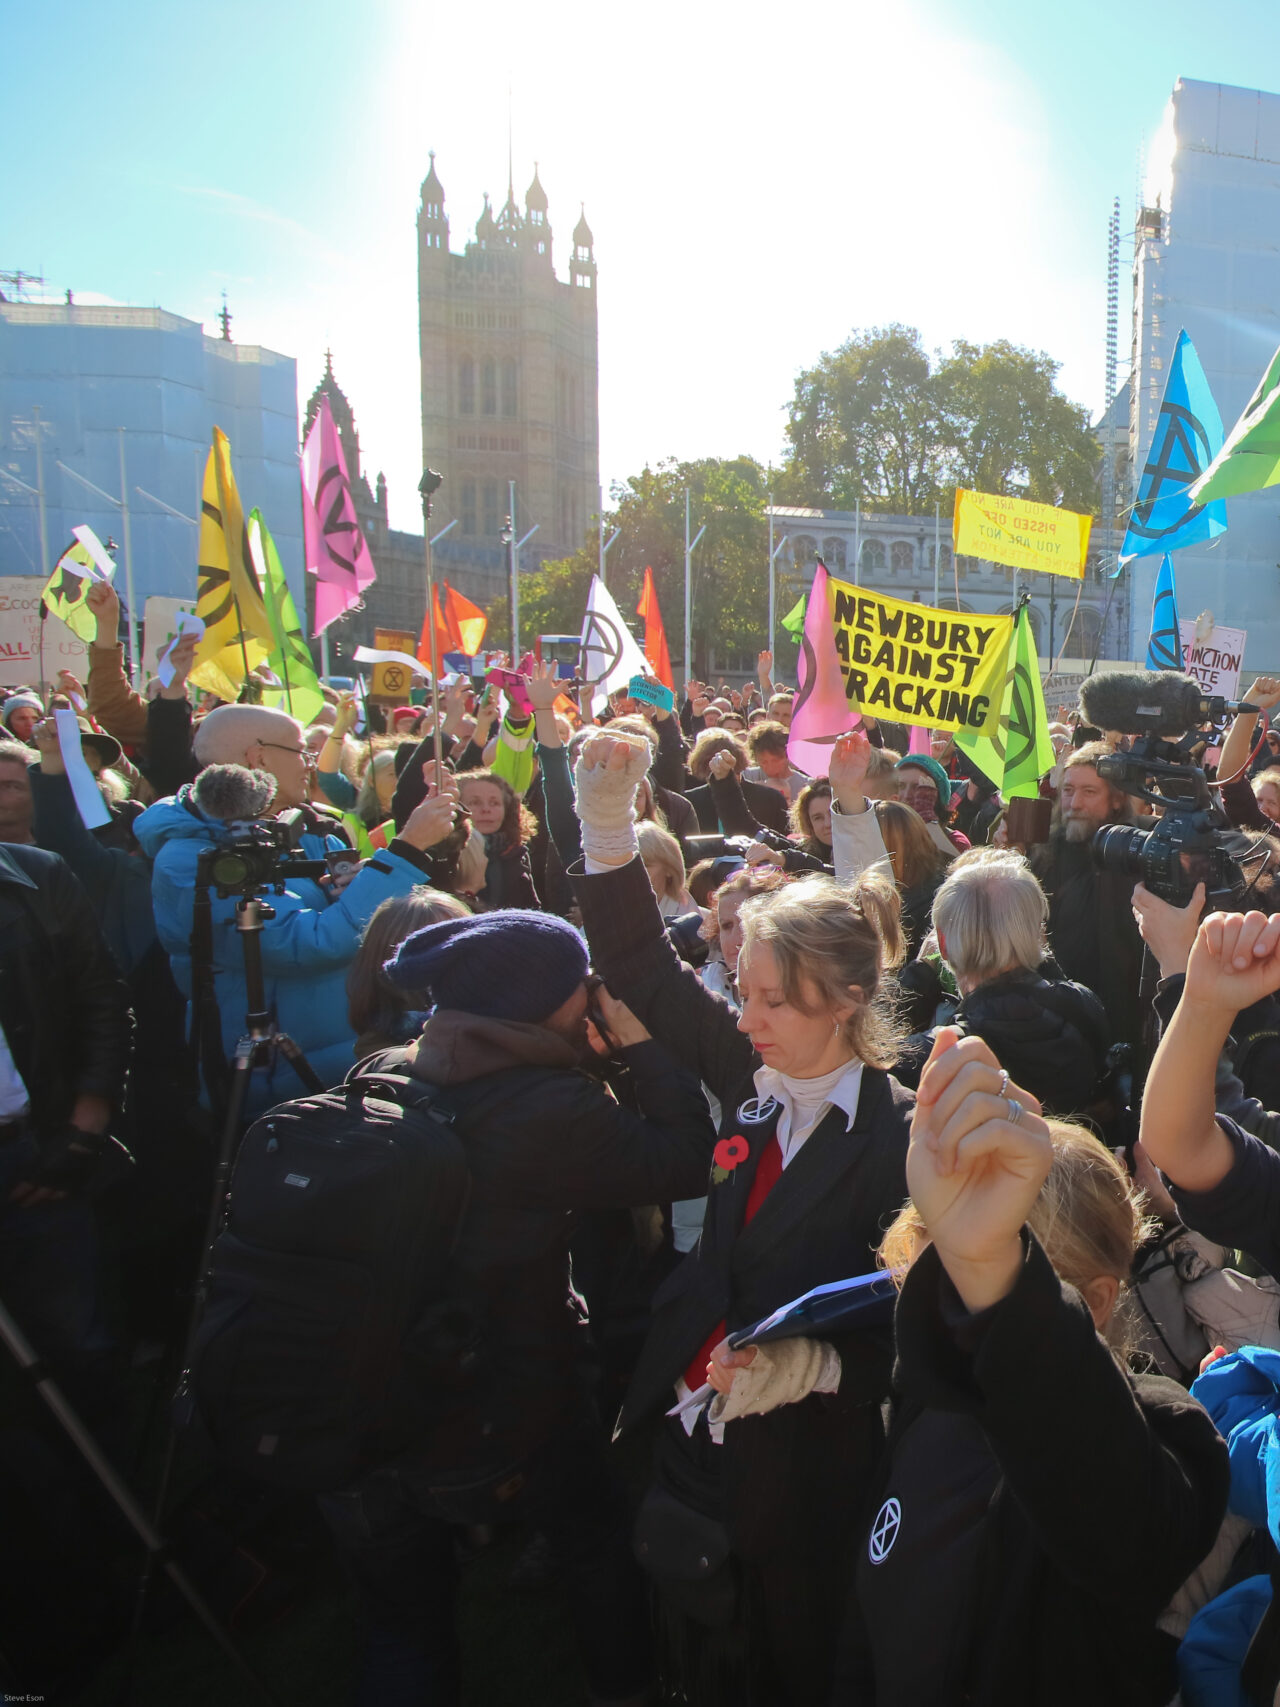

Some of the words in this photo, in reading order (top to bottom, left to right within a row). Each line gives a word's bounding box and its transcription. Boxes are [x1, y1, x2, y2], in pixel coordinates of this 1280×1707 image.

[834, 589, 997, 655] NEWBURY
[834, 628, 981, 688] AGAINST
[1043, 674, 1084, 690] ANTED
